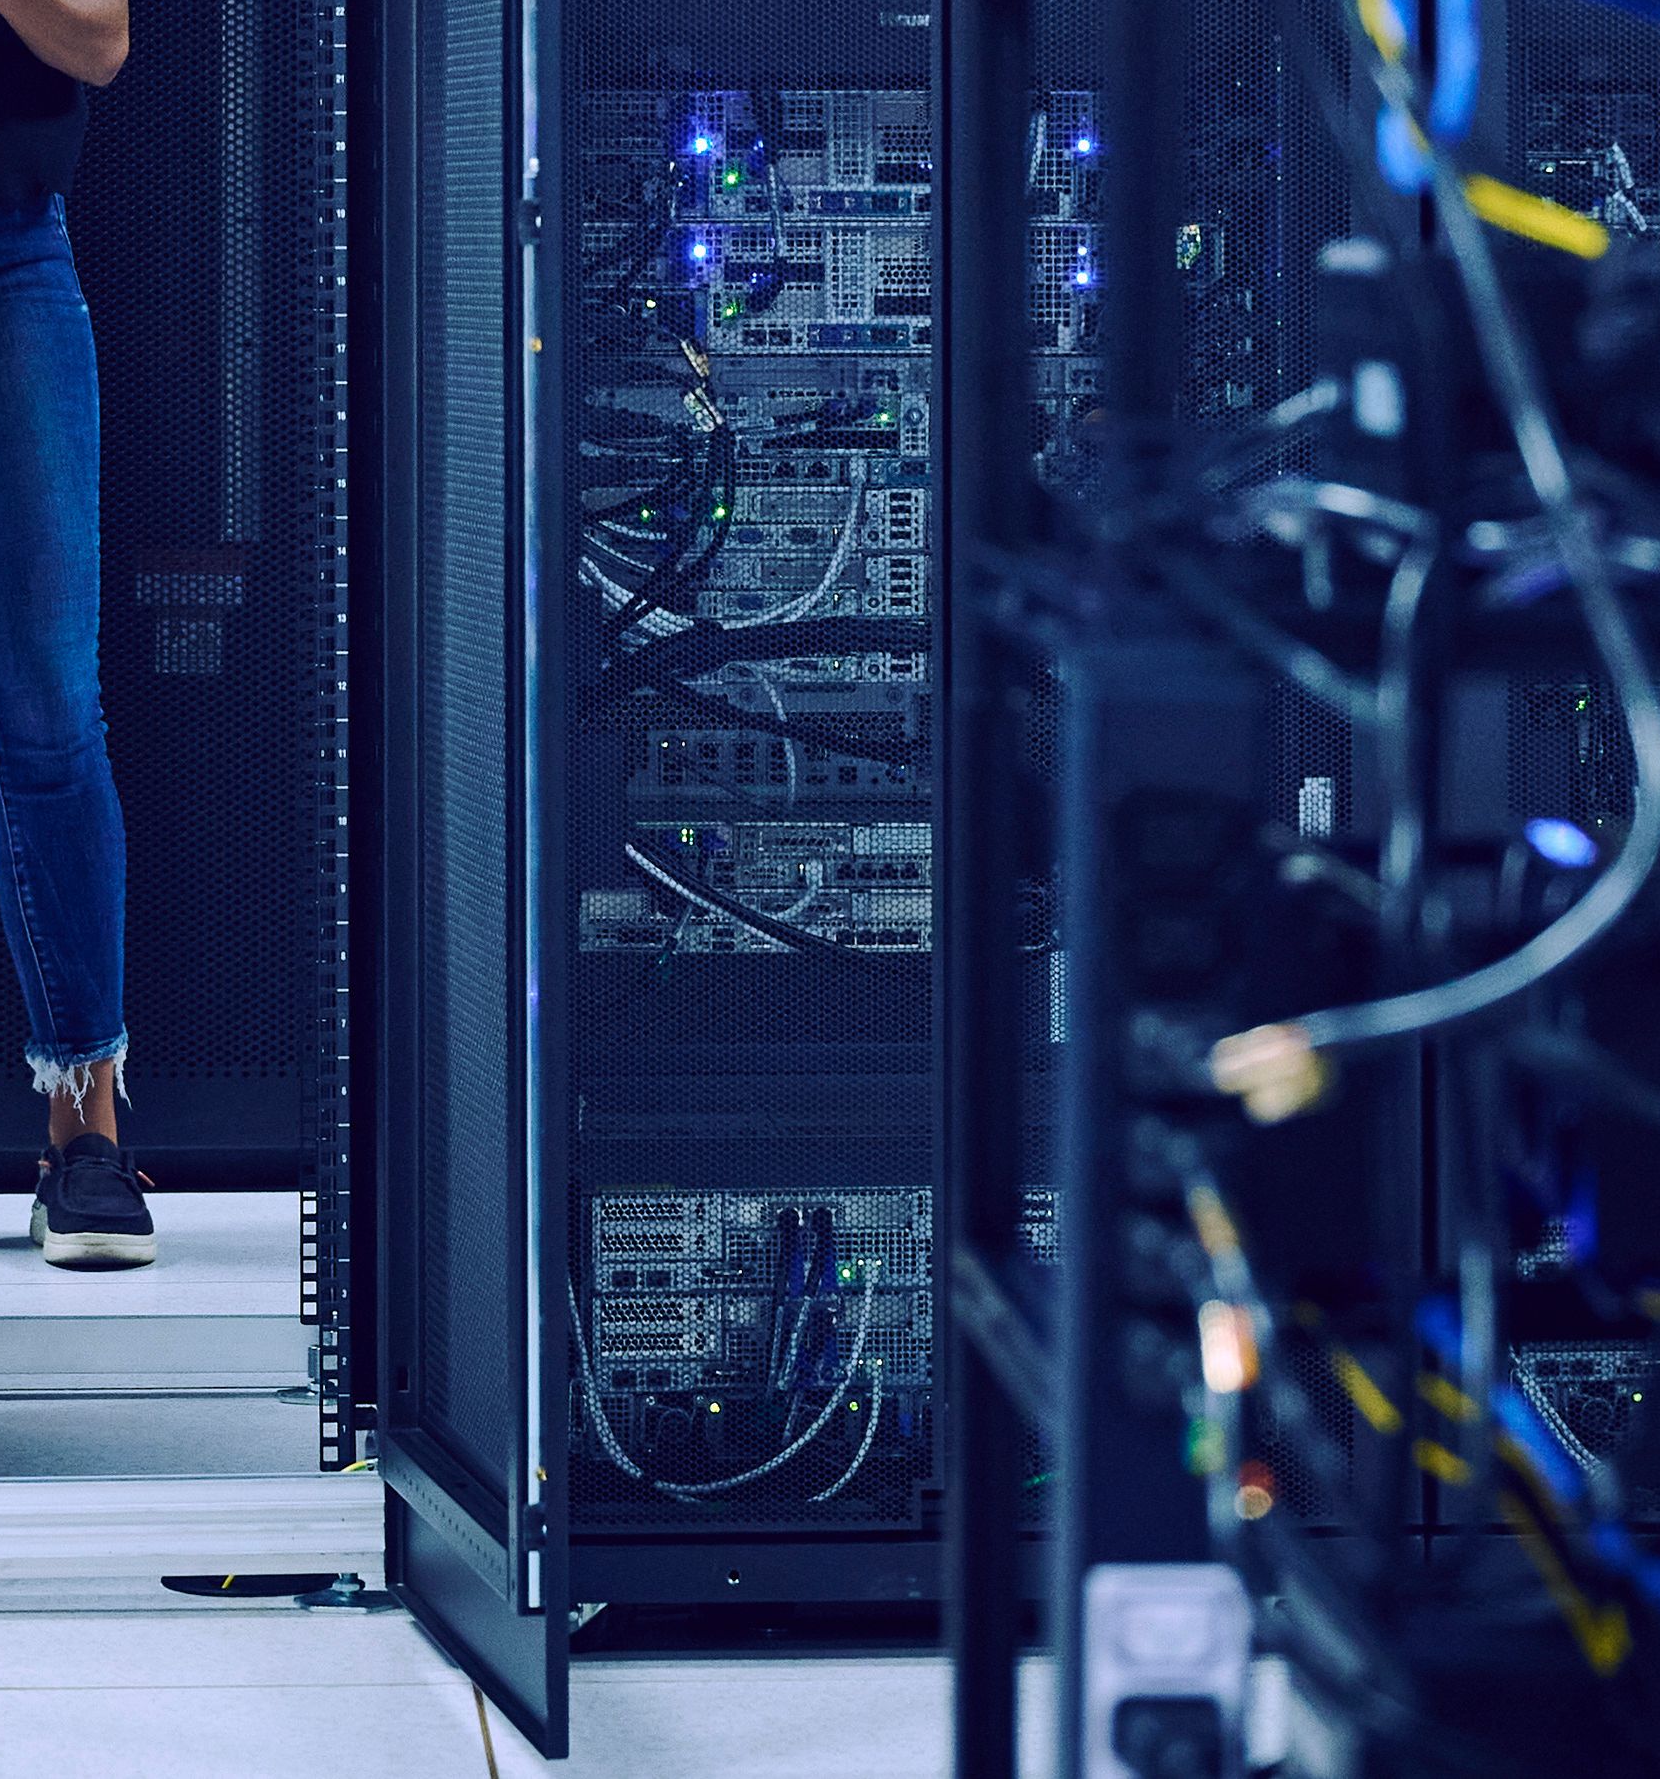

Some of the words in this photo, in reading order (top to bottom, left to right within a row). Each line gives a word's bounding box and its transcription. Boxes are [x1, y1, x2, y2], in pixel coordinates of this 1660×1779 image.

[336, 209, 346, 218] 19
[336, 276, 346, 286] 18
[336, 343, 346, 353] 17
[337, 411, 346, 421] 16
[337, 478, 346, 488] 15
[337, 546, 346, 555] 14
[337, 613, 347, 623] 13
[337, 681, 347, 691] 12
[338, 749, 346, 758] 11
[338, 816, 347, 826] 10
[340, 884, 346, 893] 9
[340, 951, 346, 961] 8
[341, 1019, 346, 1028] 7
[341, 1086, 347, 1096] 6
[342, 1154, 347, 1163] 5
[342, 1221, 347, 1230] 4
[342, 1289, 347, 1298] 3
[342, 1357, 347, 1366] 2
[342, 1424, 346, 1433] 1
